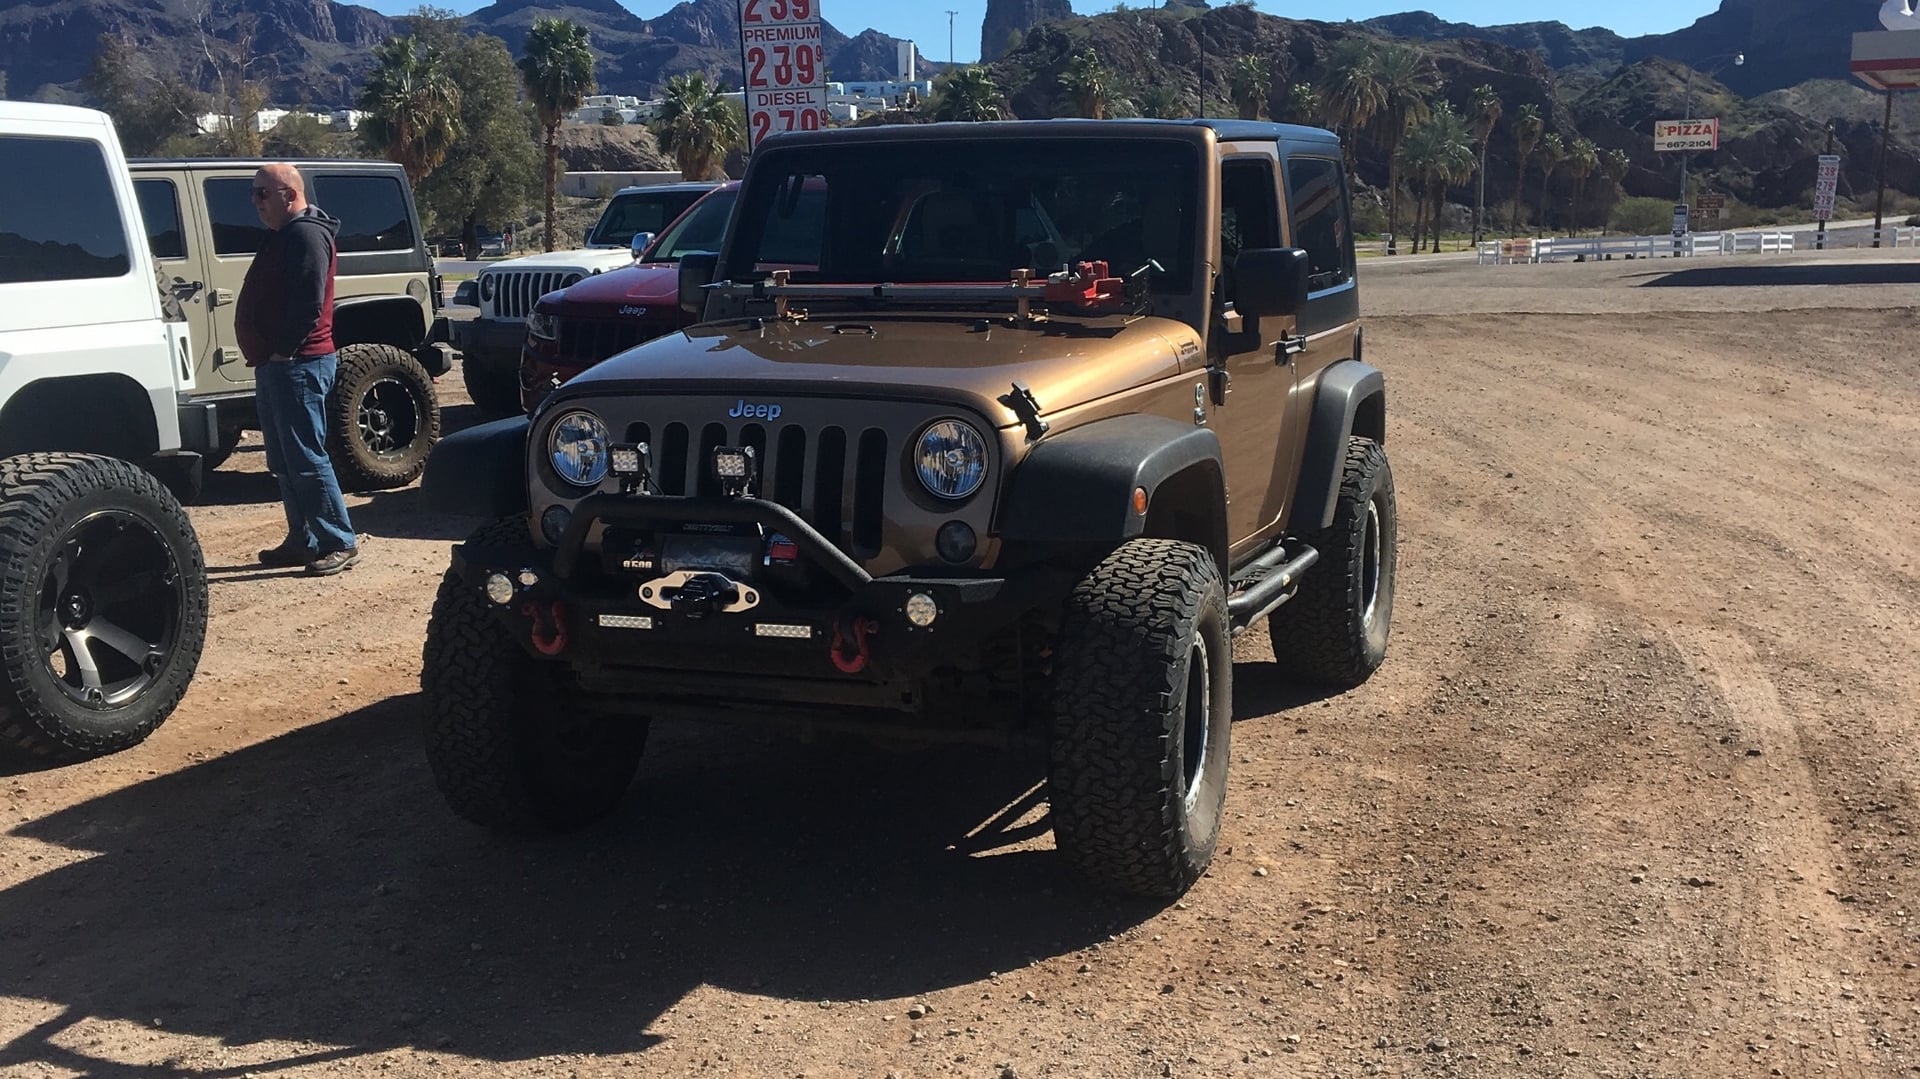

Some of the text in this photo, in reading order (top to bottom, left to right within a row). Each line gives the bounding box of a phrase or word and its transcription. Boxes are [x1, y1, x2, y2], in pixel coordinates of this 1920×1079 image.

[744, 26, 819, 43] PREMIUM
[757, 91, 816, 107] DIESEL
[1667, 124, 1712, 136] PIZZA
[618, 304, 647, 317] Jeep
[728, 399, 782, 422] Jeep
